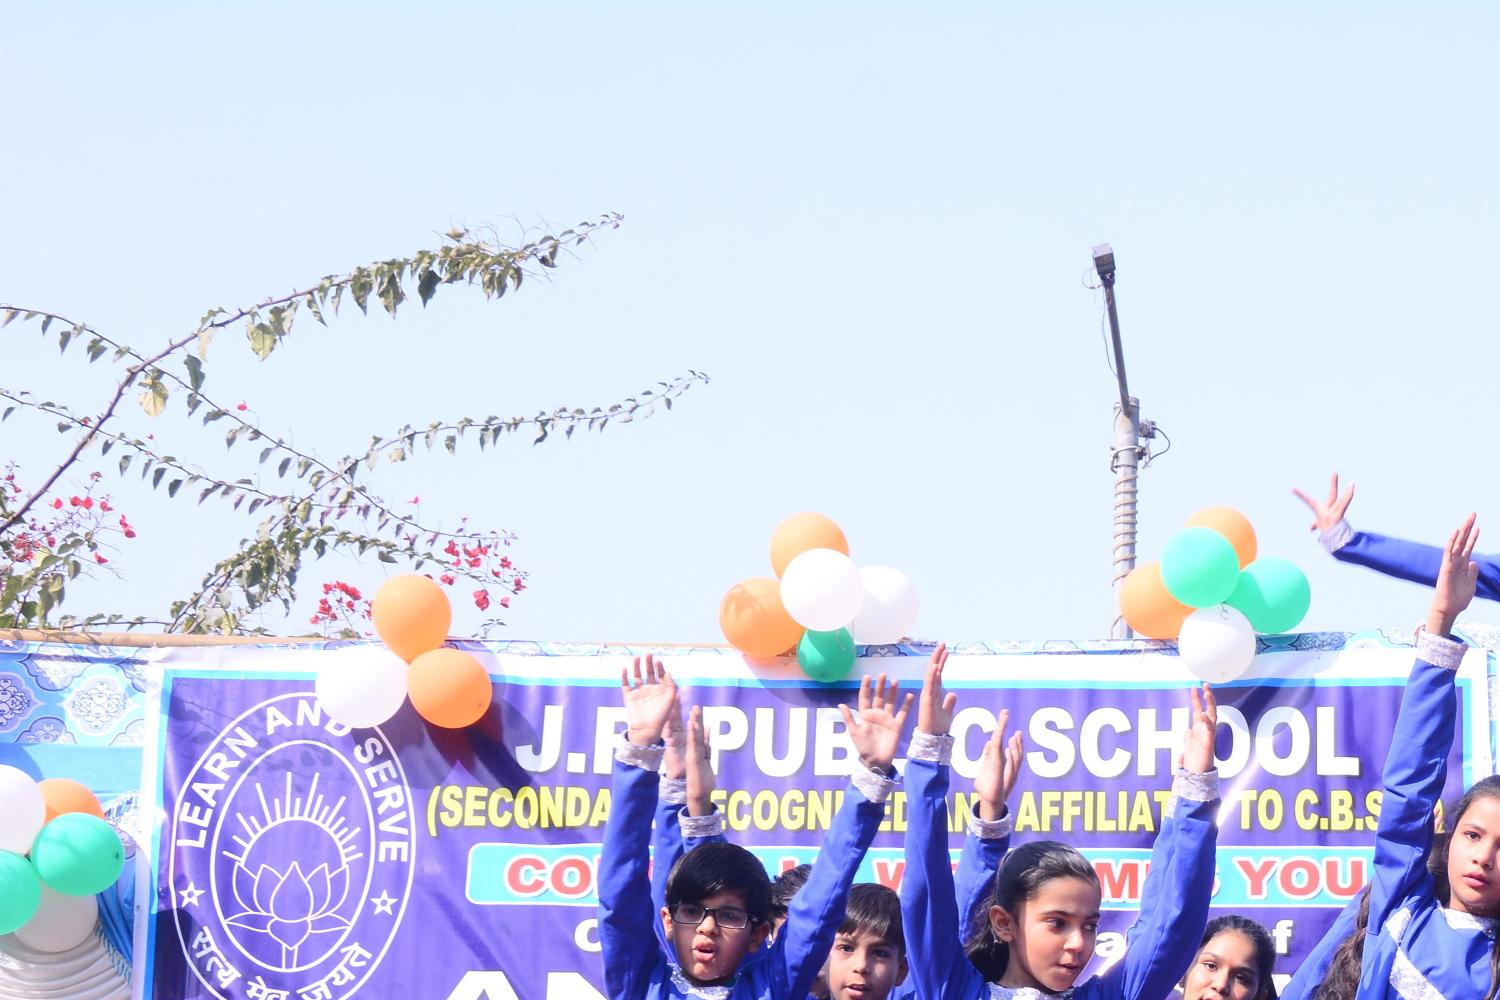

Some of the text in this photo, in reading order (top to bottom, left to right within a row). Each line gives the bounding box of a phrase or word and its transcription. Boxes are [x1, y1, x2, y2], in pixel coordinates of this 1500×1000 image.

[702, 706, 1000, 779] PUBC
[1026, 705, 1360, 779] SCHOOL
[176, 727, 258, 848] LEARN
[353, 737, 409, 863] SERVE
[426, 785, 656, 837] (SECONDA
[709, 789, 908, 833] ECOGNED
[1014, 790, 1172, 833] AFFILIAT
[1234, 789, 1285, 832] TO
[1235, 859, 1368, 897] YOU
[191, 925, 243, 990] सत्य
